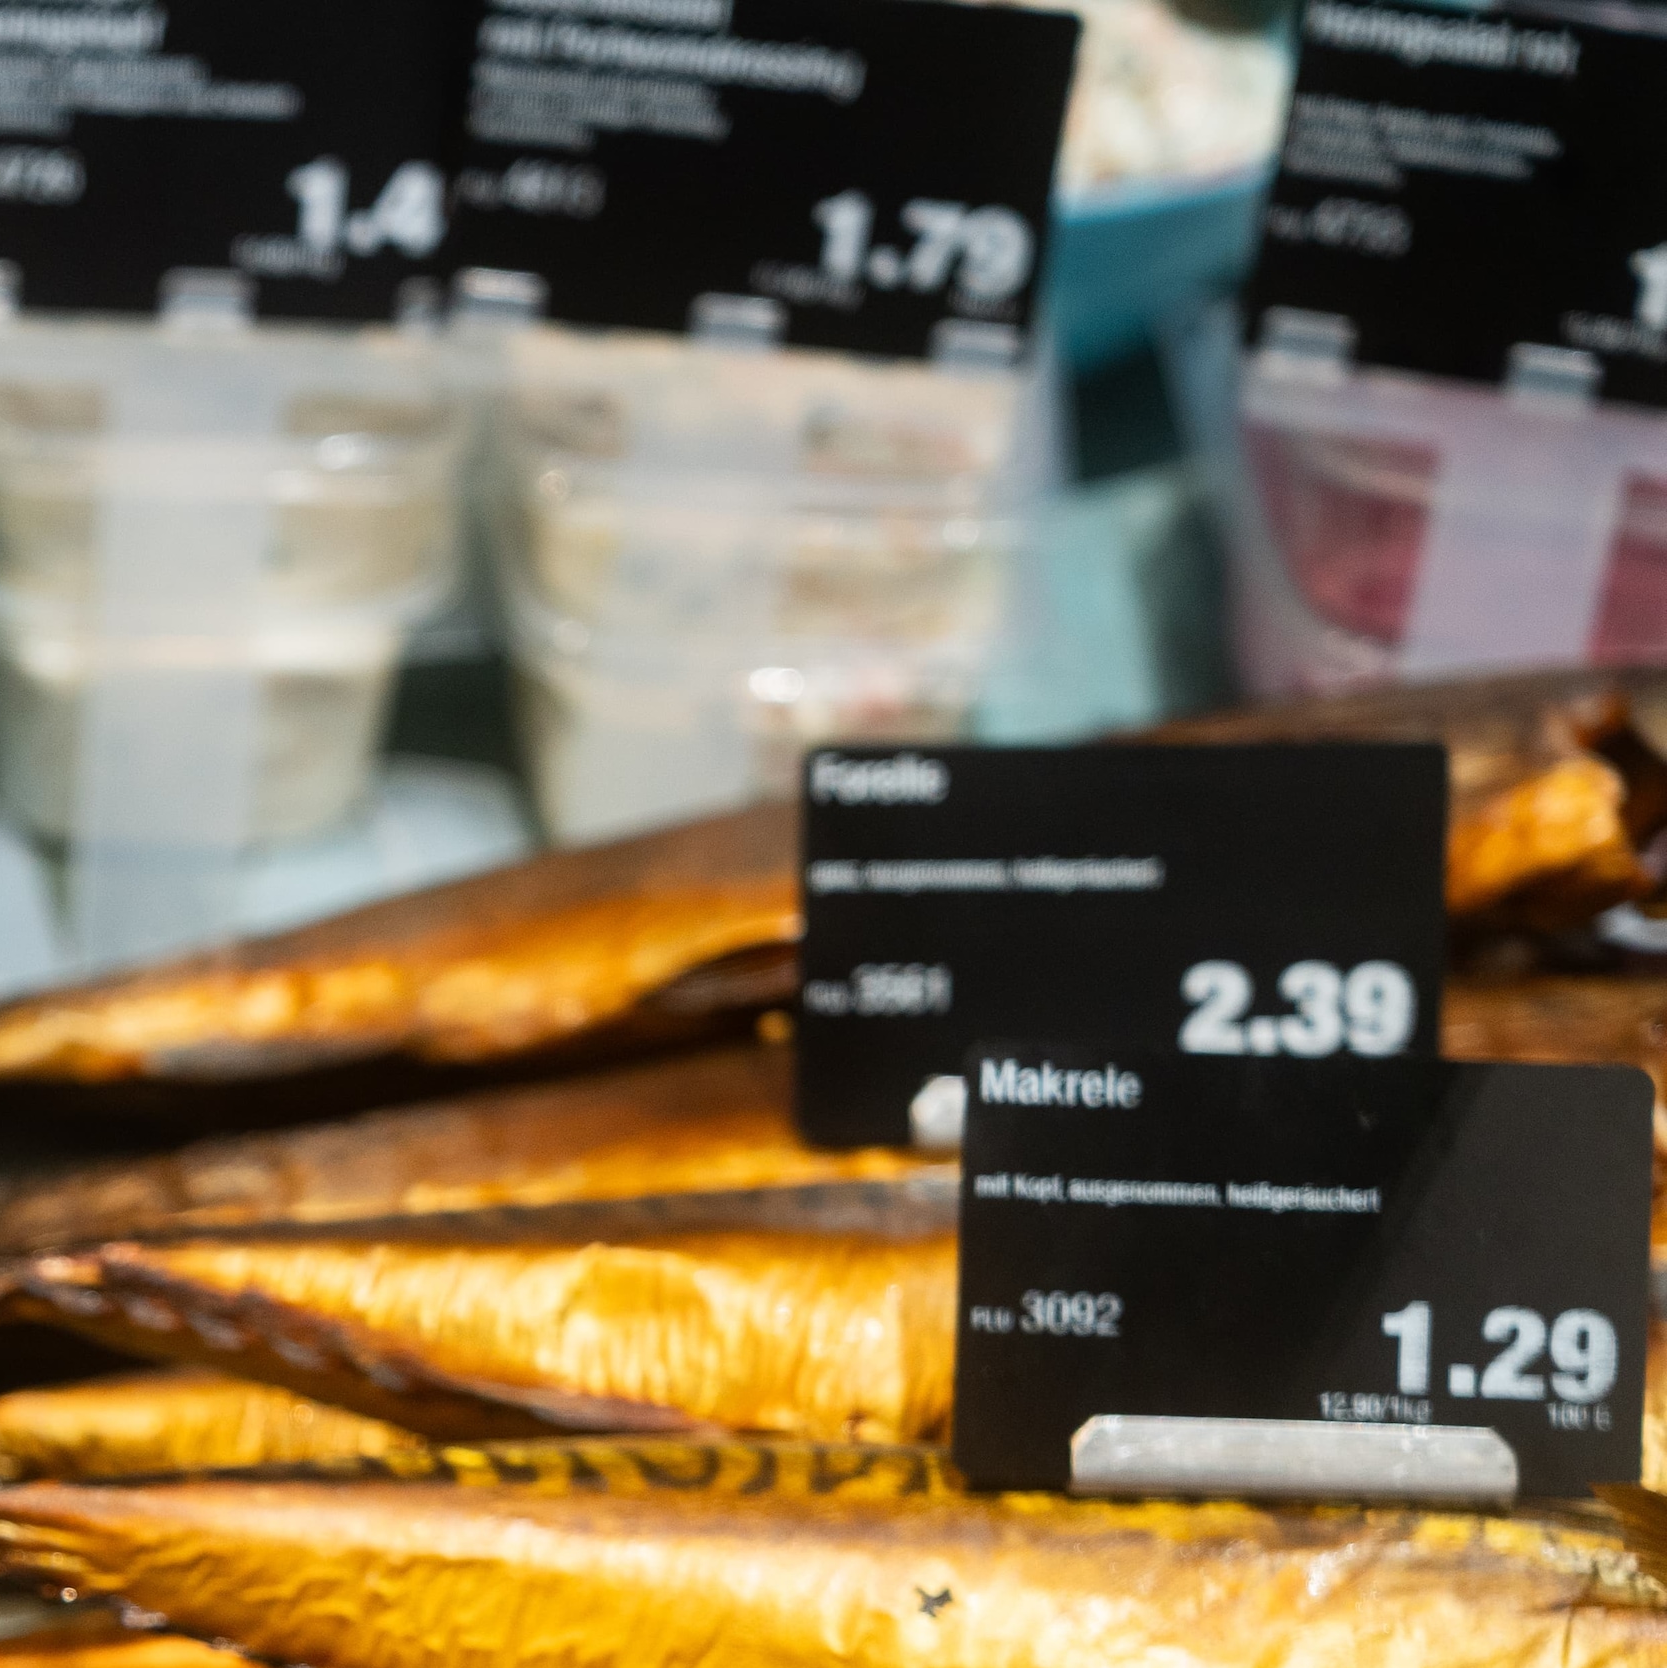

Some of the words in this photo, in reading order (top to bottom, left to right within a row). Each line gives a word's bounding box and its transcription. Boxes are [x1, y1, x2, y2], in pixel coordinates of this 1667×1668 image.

[287, 156, 446, 258] 1.4
[812, 190, 1036, 298] 1.79
[1178, 960, 1417, 1058] 2.39
[979, 1058, 1140, 1107] Makrele
[1020, 1291, 1121, 1336] 3092
[1383, 1304, 1616, 1401] 1.29
